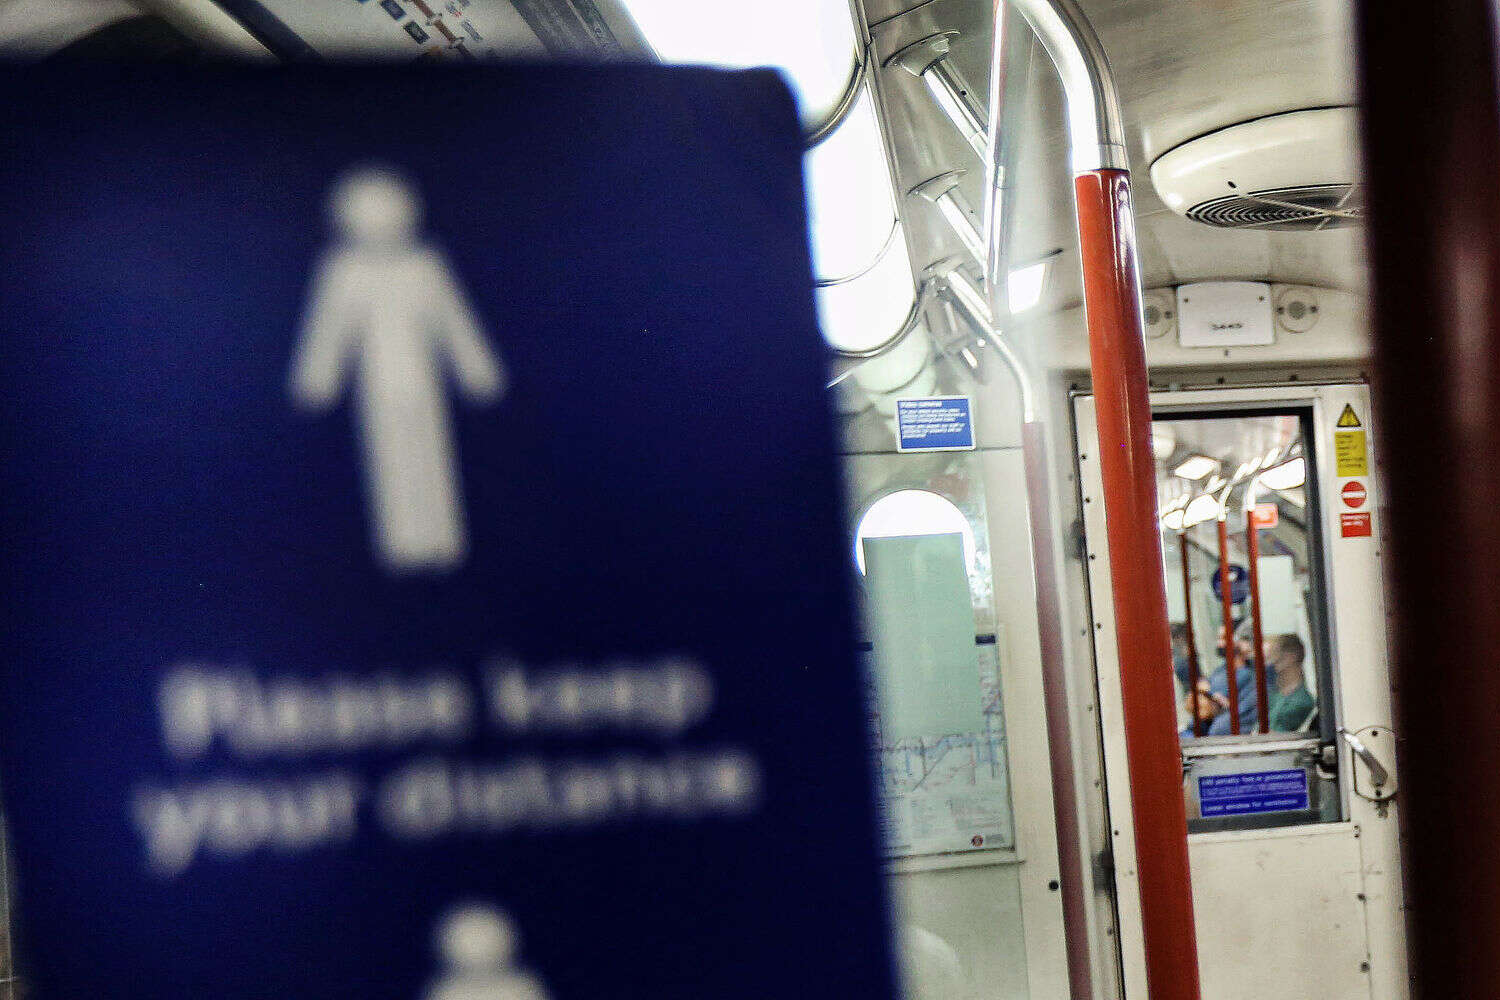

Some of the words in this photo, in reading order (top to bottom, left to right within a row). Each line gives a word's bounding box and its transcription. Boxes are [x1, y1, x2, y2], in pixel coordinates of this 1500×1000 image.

[158, 662, 470, 758] Please
[488, 654, 714, 732] keep
[136, 774, 354, 874] your
[380, 752, 757, 839] distance
